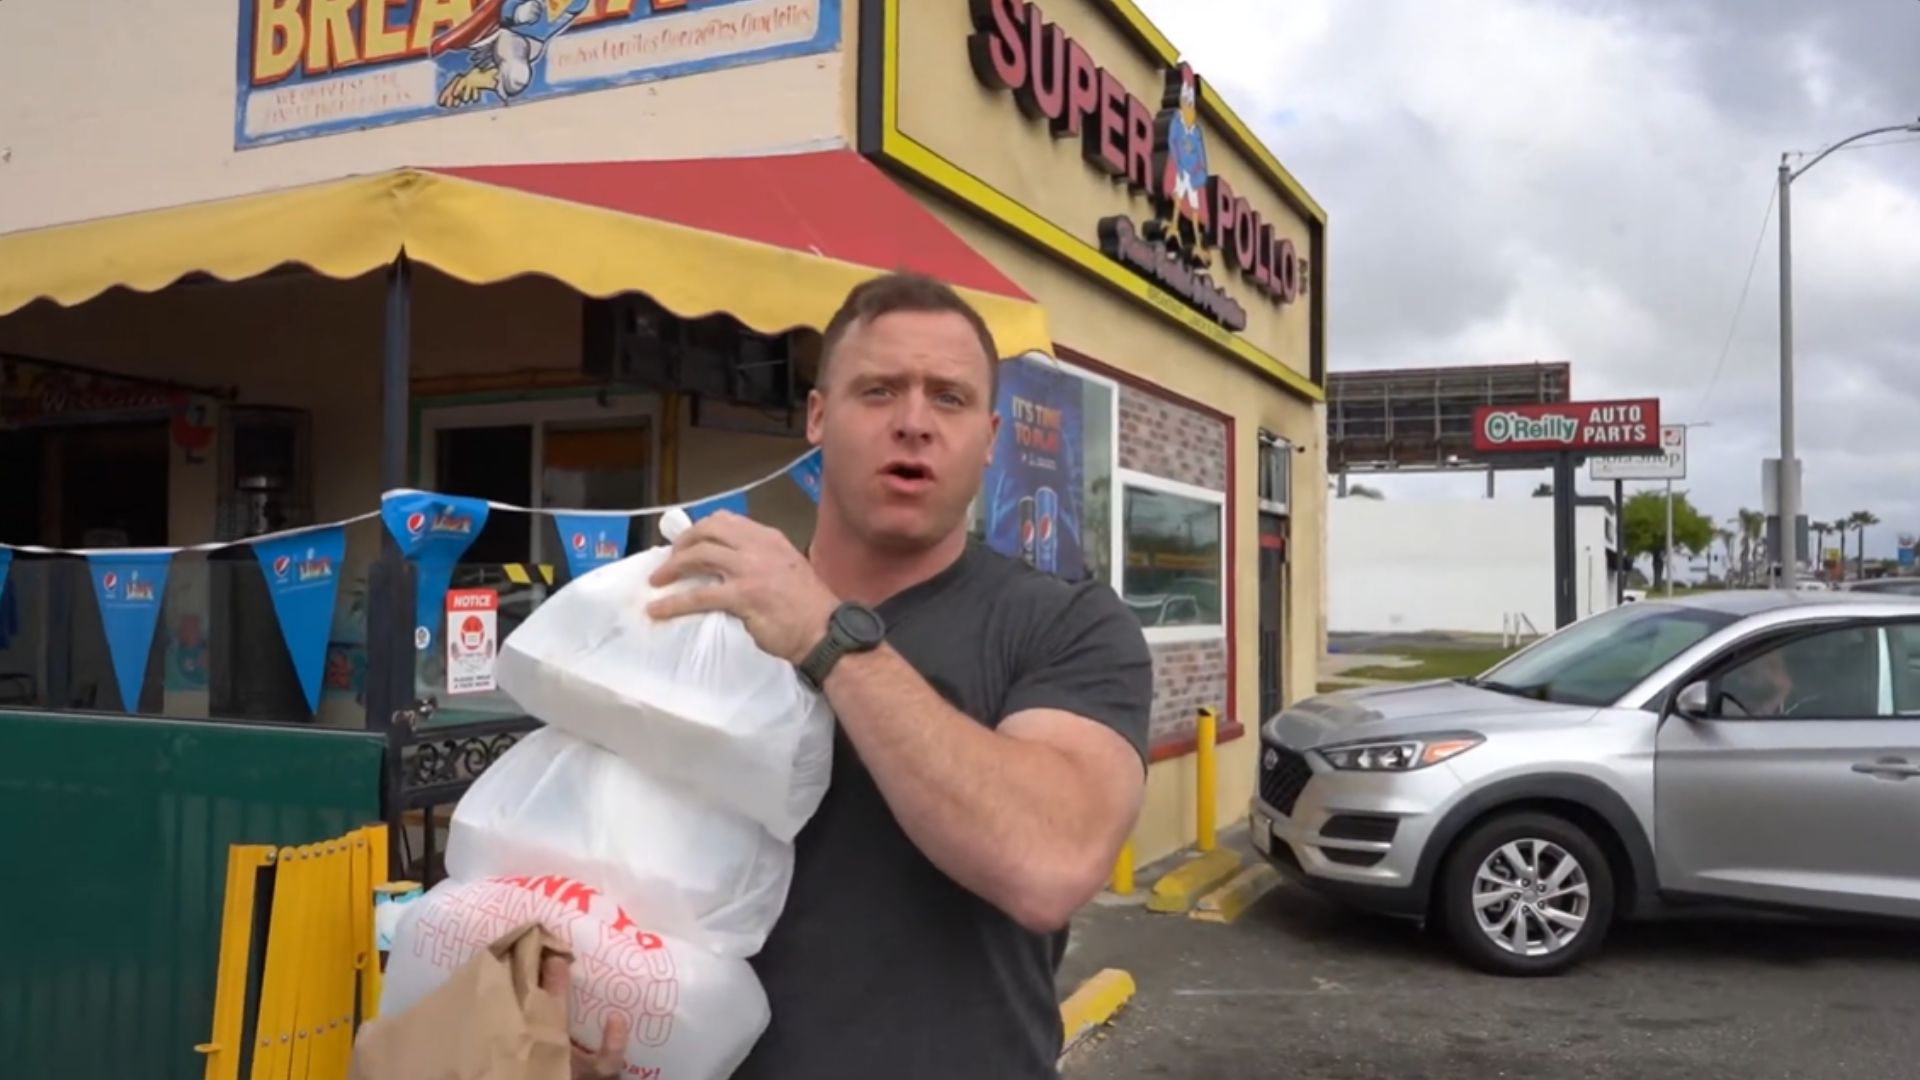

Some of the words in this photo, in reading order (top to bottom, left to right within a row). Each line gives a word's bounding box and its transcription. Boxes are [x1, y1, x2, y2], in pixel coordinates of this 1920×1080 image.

[988, 0, 1154, 195] SUPER
[1216, 176, 1299, 305] POLLO
[1486, 412, 1577, 443] O'Reilly
[1589, 404, 1642, 423] AUTO
[1014, 421, 1032, 446] TO
[1583, 424, 1647, 443] PARTS
[453, 593, 492, 608] NOTICE
[594, 920, 676, 981] YOU
[582, 952, 680, 1016] YOU
[575, 987, 675, 1048] YOU
[623, 1061, 662, 1080] ay!
